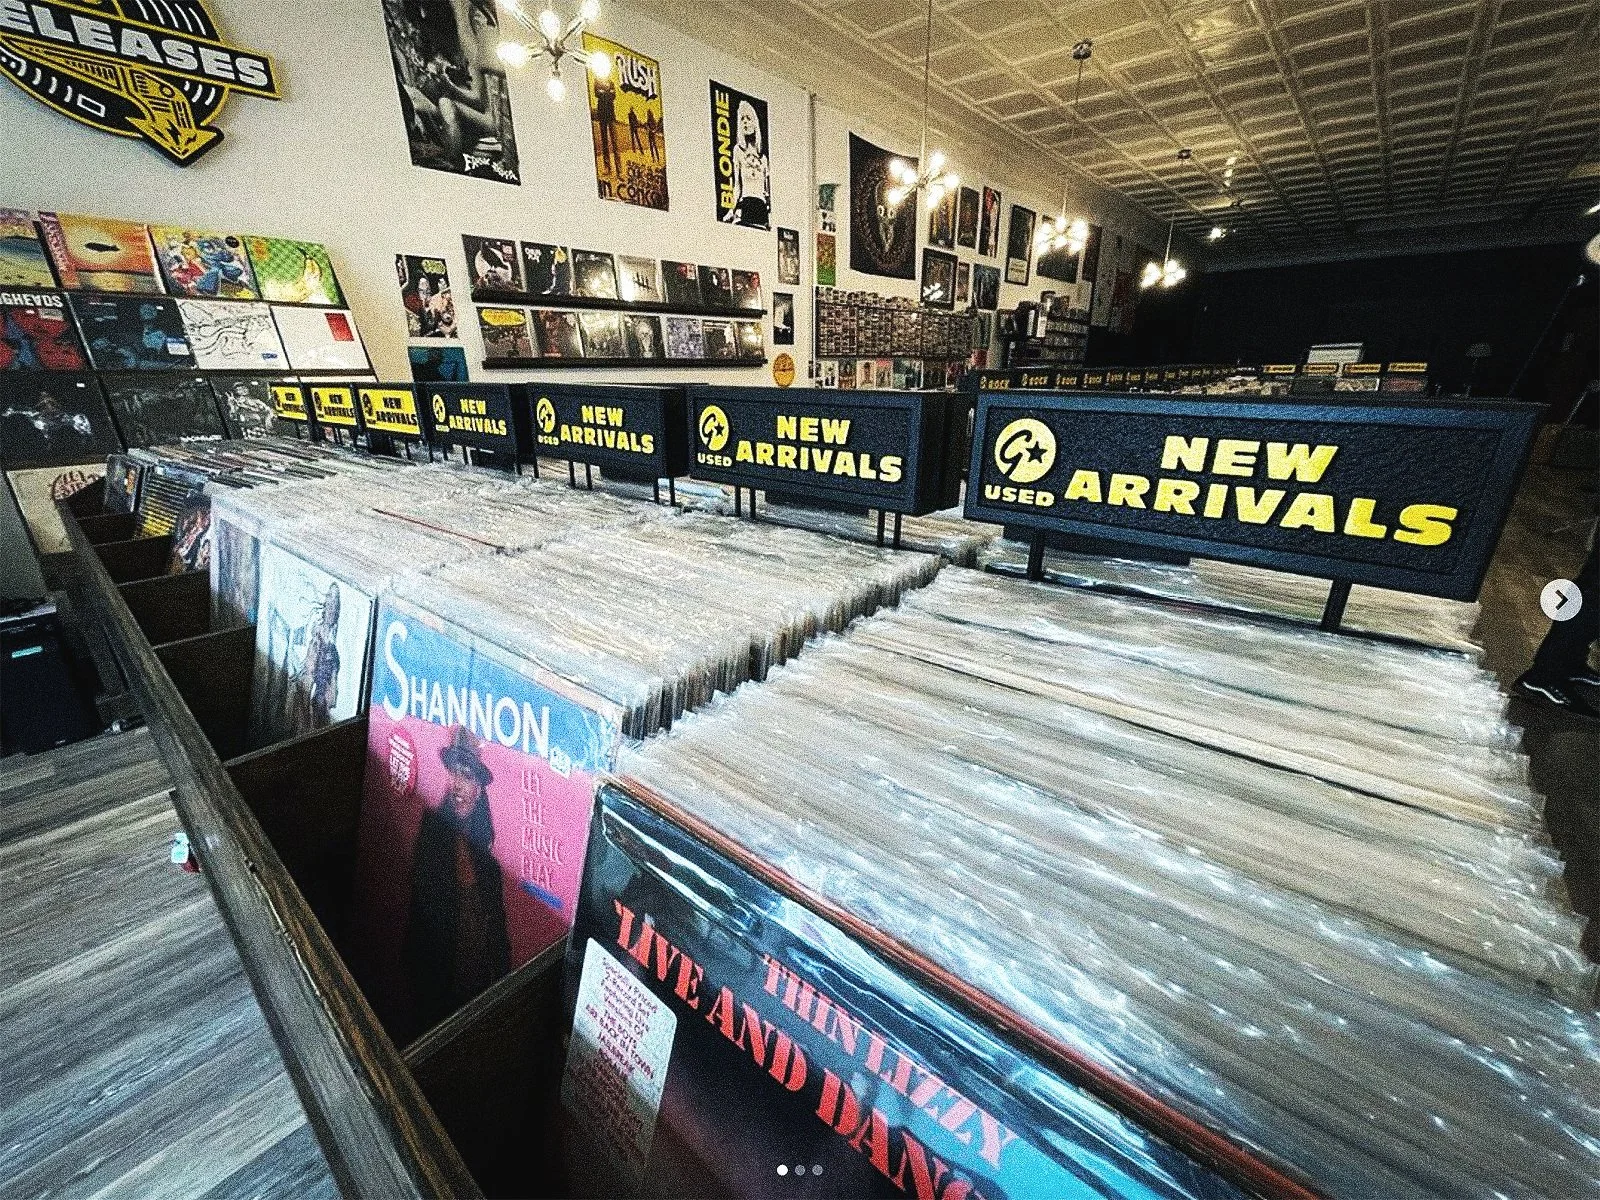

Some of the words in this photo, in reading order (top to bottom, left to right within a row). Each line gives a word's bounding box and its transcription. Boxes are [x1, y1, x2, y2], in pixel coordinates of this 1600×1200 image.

[615, 54, 657, 98] RUSH
[715, 89, 735, 209] BLONDIE
[460, 399, 486, 415] NEW
[581, 405, 623, 427] NEW
[450, 415, 507, 436] ARRIVALS
[560, 424, 654, 454] ARRIVALS
[777, 415, 851, 445] NEW
[697, 452, 732, 467] USED
[736, 440, 902, 483] ARRIVALS
[1161, 435, 1338, 483] NEW
[984, 484, 1055, 507] USED
[1064, 470, 1458, 546] ARRIVALS
[613, 898, 704, 1010] LIVE
[705, 985, 808, 1092] AND
[763, 953, 860, 1056] THIN
[863, 1032, 1018, 1169] LIZZY
